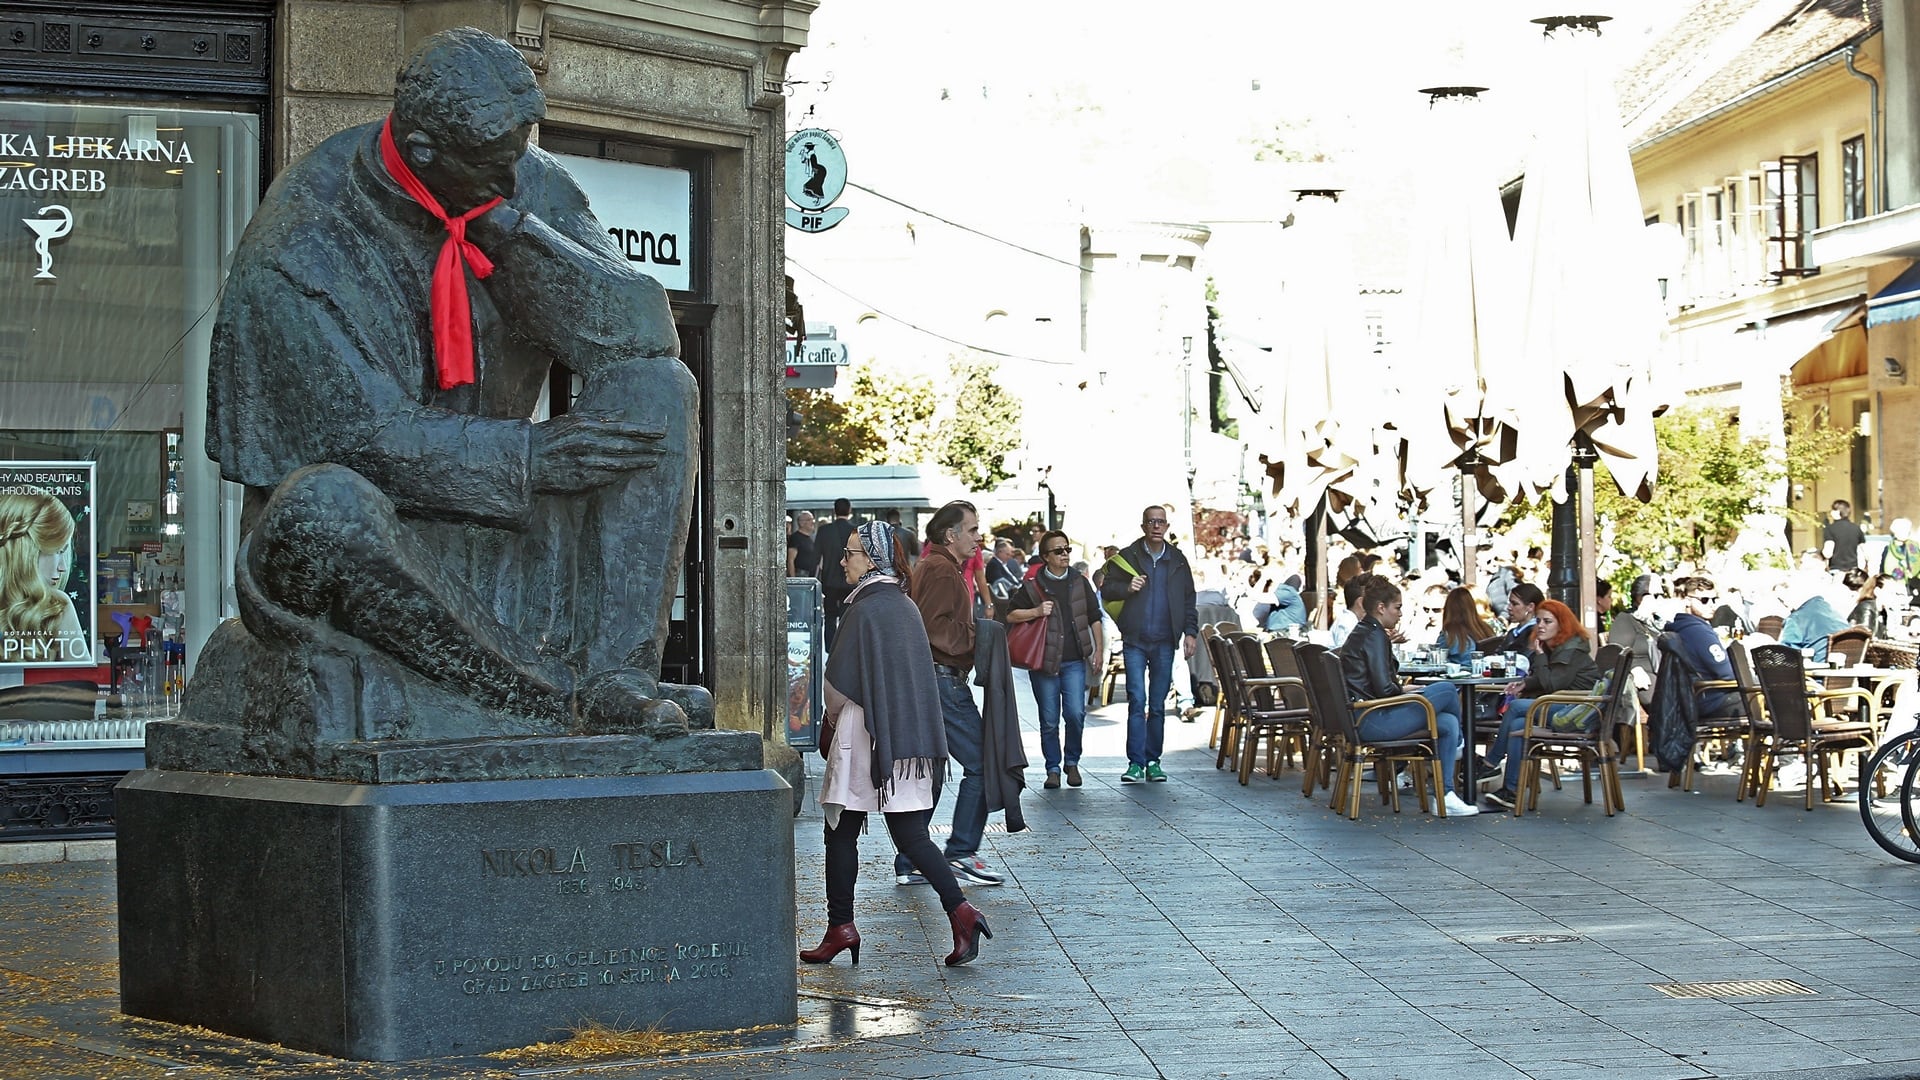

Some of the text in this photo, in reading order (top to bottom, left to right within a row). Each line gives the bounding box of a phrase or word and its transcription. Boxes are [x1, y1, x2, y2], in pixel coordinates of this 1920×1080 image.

[0, 134, 194, 164] KA LJEKARNA
[0, 168, 106, 193] ZAGREB
[801, 216, 823, 229] PIF
[808, 347, 837, 363] caffe
[13, 473, 34, 483] AND
[35, 473, 85, 483] BEAUTIFUL
[0, 486, 82, 496] HROUGH PLANTS
[3, 637, 86, 660] PHYTO
[481, 840, 704, 878] NIKOLA TESLA
[434, 959, 447, 975] U
[452, 954, 522, 975] POVODU
[462, 977, 511, 995] GRAD
[521, 971, 589, 992] ZAGREB
